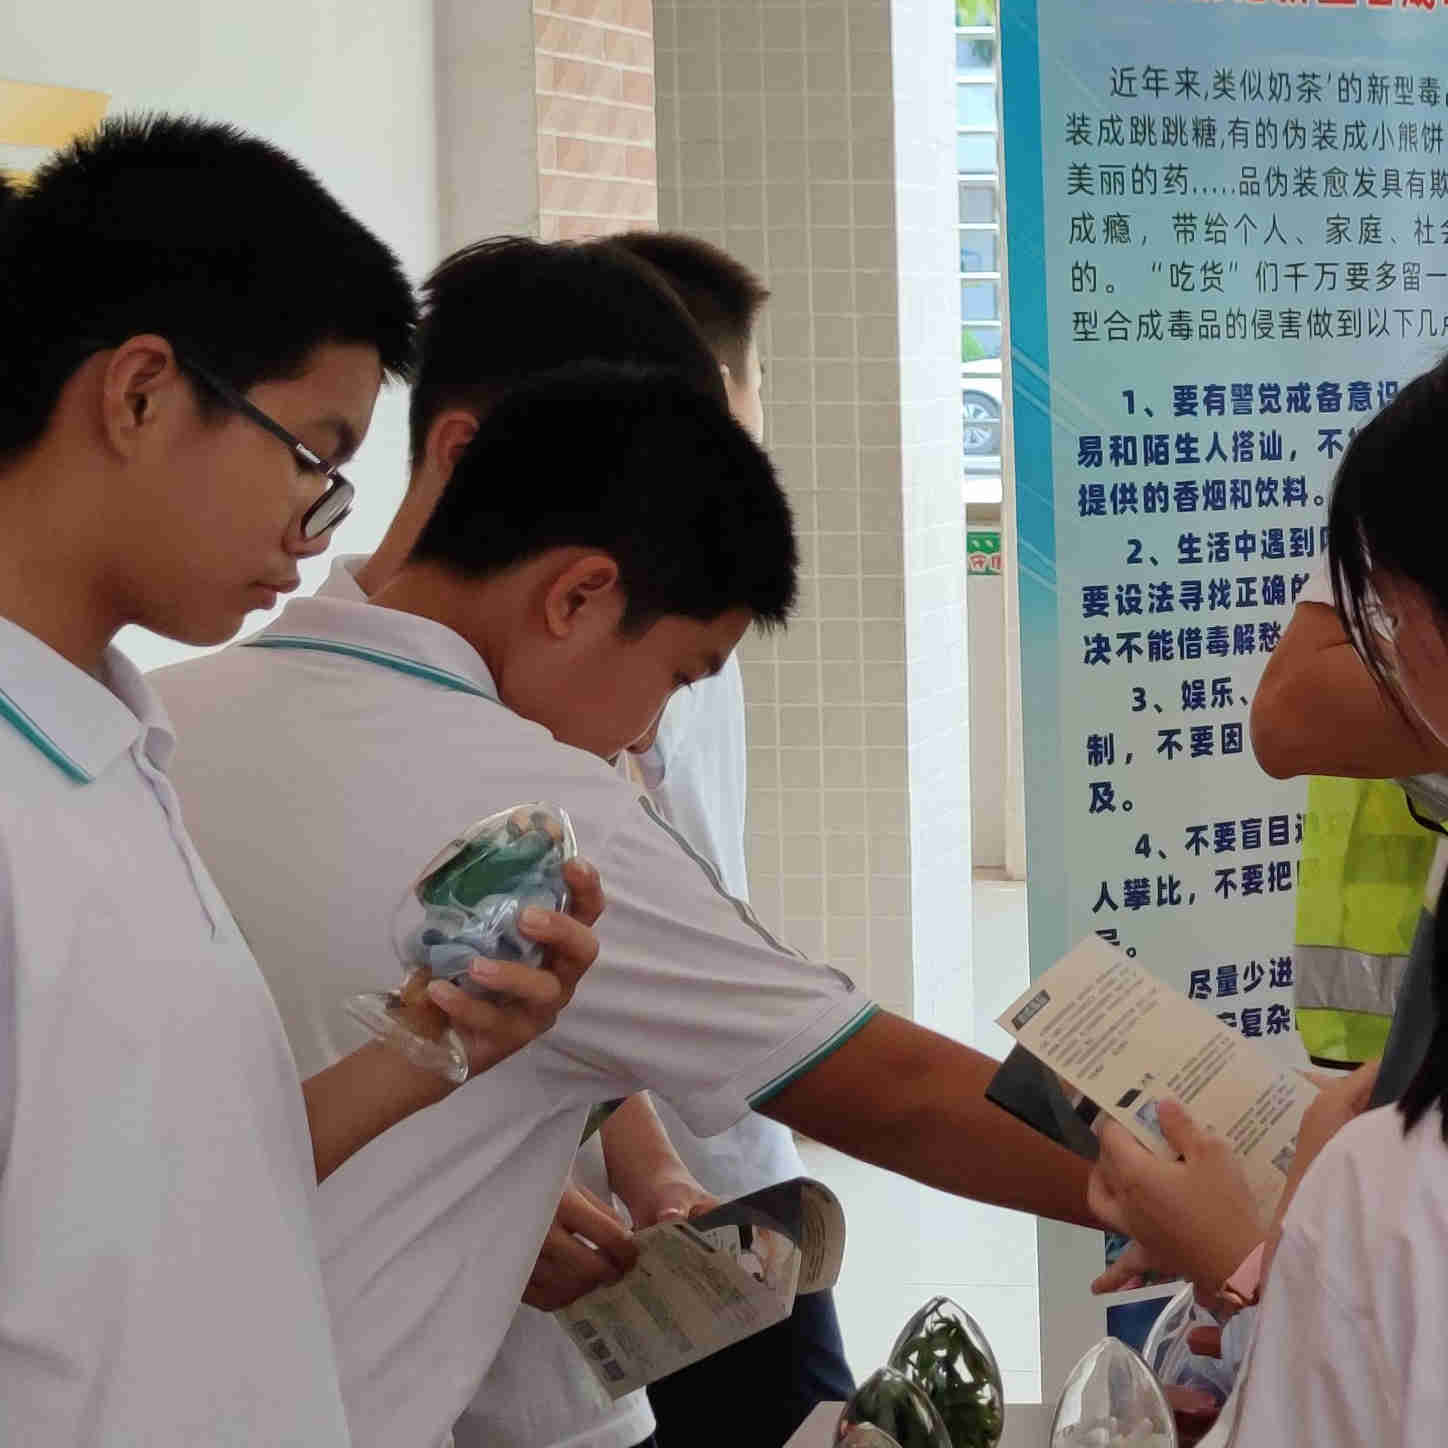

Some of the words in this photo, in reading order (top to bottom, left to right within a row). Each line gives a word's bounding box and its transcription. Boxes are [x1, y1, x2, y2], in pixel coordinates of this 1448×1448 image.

[1077, 427, 1360, 468] 易和陌生人搭讪，不
[1078, 475, 1324, 517] 提供的香烟和饮料。
[1089, 781, 1133, 814] 及。
[1093, 861, 1300, 913] 人攀比，不要把
[1216, 1003, 1299, 1039] 复杂
